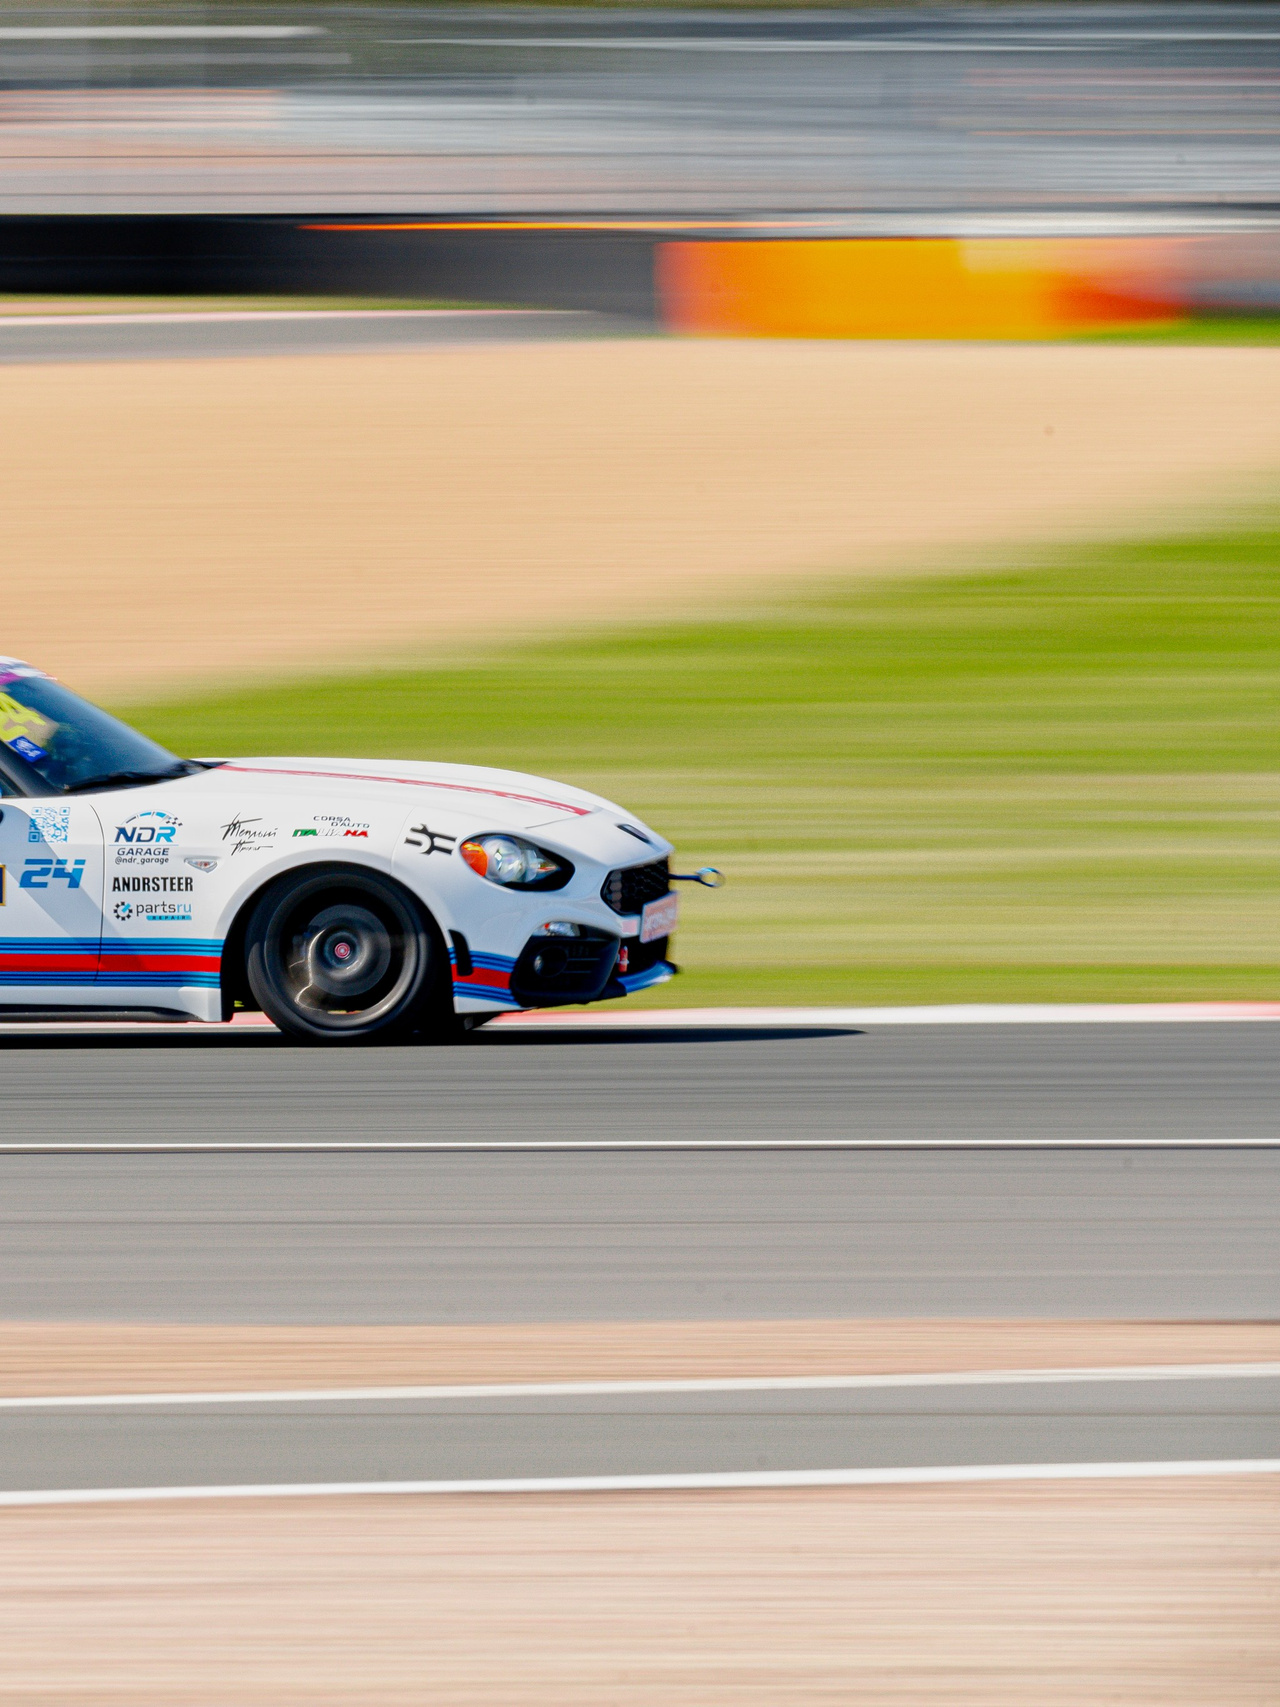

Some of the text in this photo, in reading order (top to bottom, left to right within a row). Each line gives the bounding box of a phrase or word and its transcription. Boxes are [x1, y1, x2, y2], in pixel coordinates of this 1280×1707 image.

[313, 815, 351, 823] CORSA
[114, 825, 177, 843] NDR
[291, 827, 369, 838] ITALIANA
[116, 847, 170, 856] GARAGE
[114, 856, 170, 866] @ndr_garage
[19, 858, 86, 889] 24
[111, 876, 194, 893] ANDRSTEER
